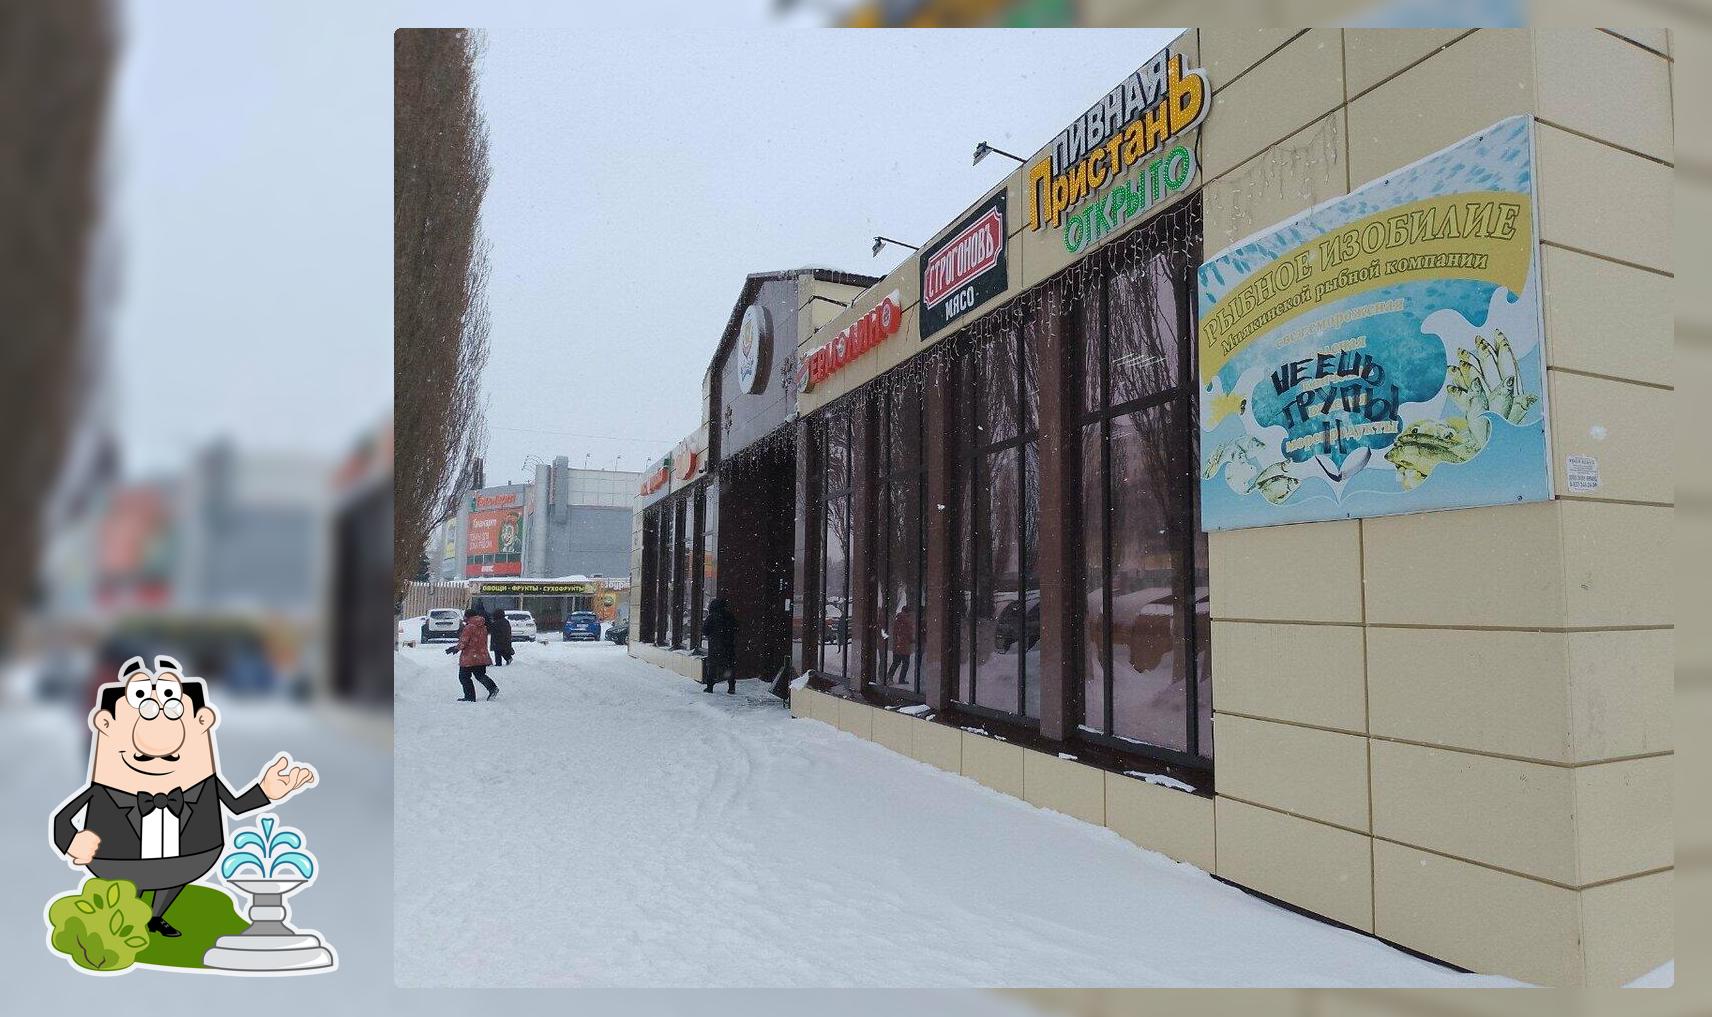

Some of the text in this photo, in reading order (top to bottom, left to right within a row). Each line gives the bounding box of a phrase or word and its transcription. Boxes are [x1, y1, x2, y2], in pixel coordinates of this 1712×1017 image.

[1052, 49, 1169, 177] ПИВНАЯ
[1063, 145, 1191, 253] ОТКРЫТО
[928, 222, 994, 298] СТРОГОНОВЪ
[1203, 201, 1520, 348] РЫБНОЕ ИЗОБИЛИЕ
[1314, 258, 1381, 304] рыбной
[1384, 252, 1489, 276] компании
[944, 286, 975, 321] МЯСО
[482, 582, 585, 593] ОВОЩИ ФРУКТЫ СУХОФРУКТЫ
